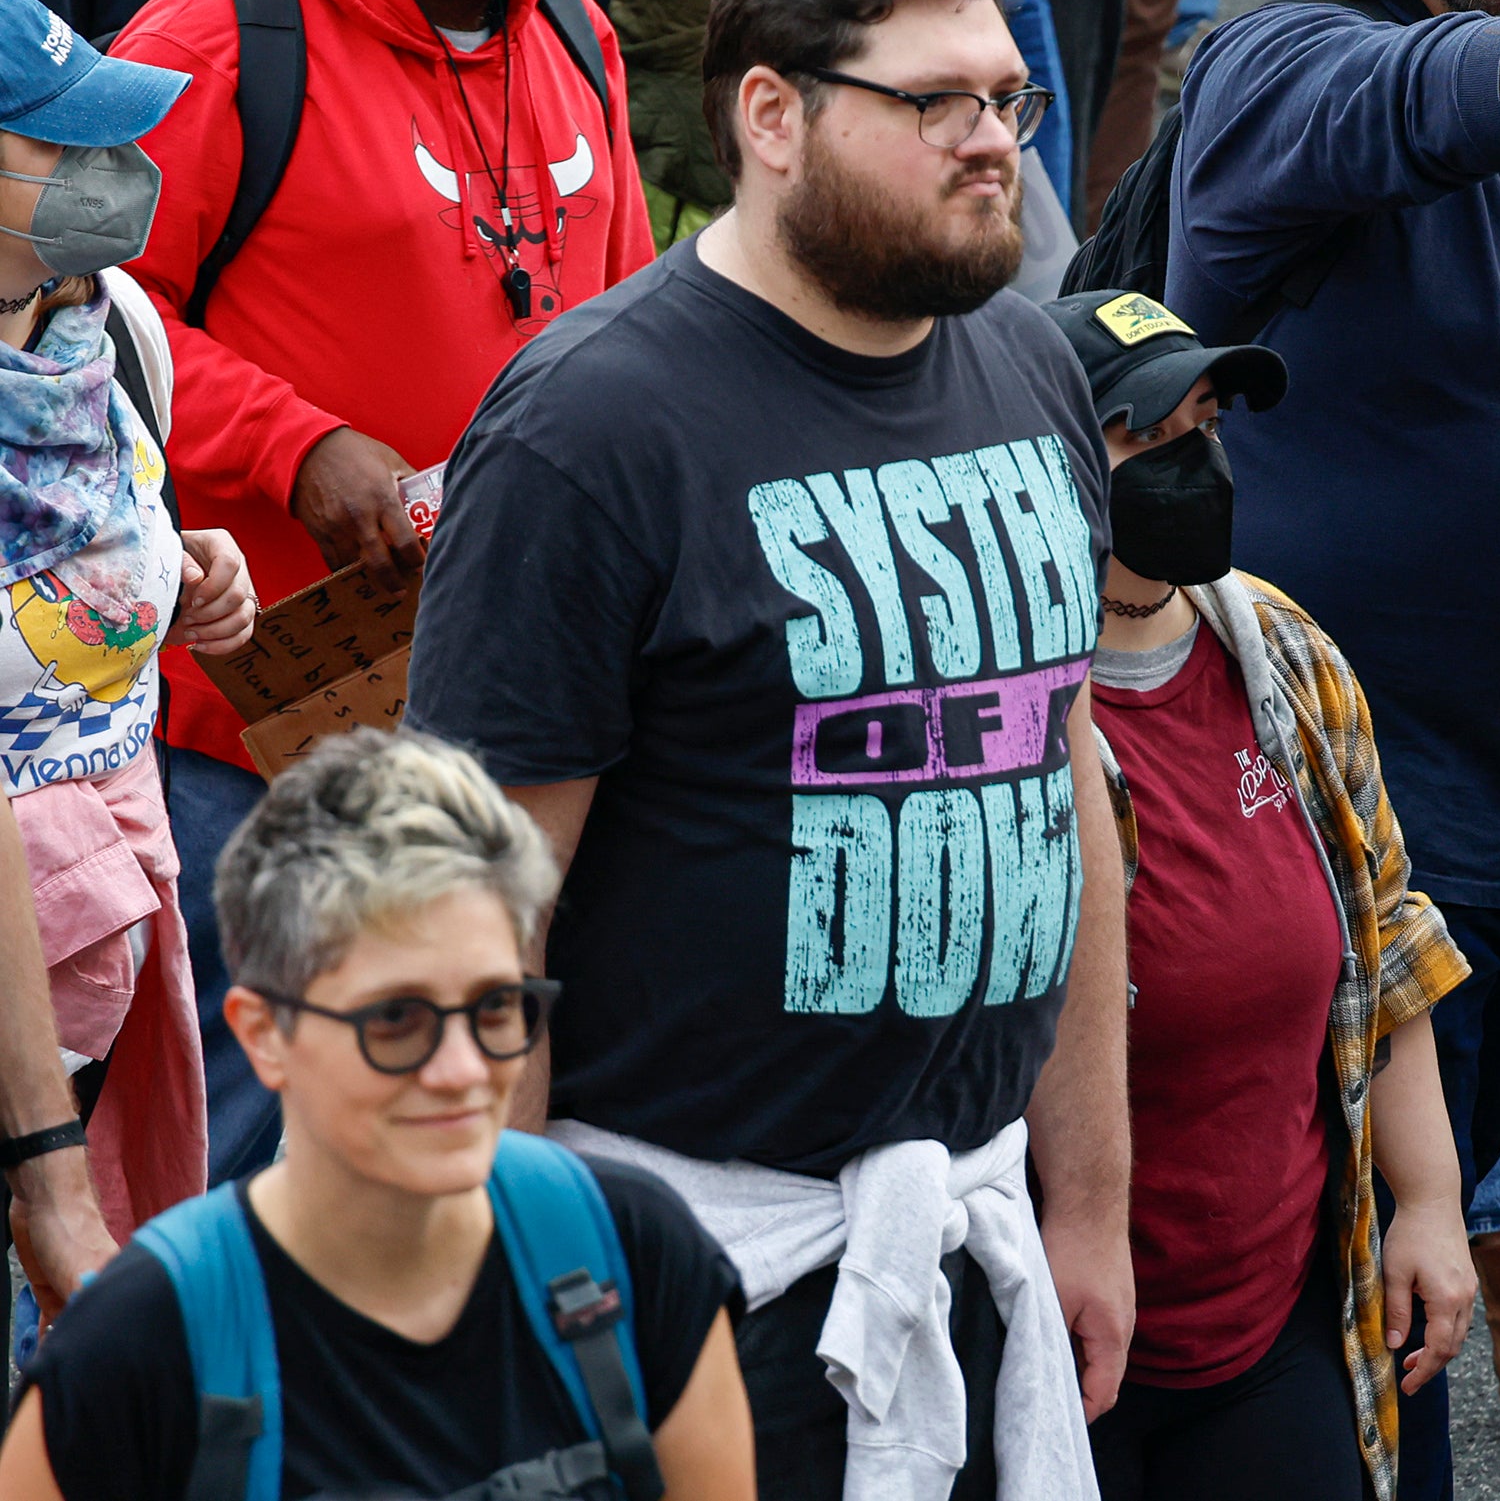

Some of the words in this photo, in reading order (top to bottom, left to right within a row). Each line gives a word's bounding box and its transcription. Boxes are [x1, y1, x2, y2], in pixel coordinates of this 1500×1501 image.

[79, 196, 105, 210] KN95
[260, 613, 306, 660] God
[814, 691, 1008, 774] OF
[0, 741, 122, 790] Vienna
